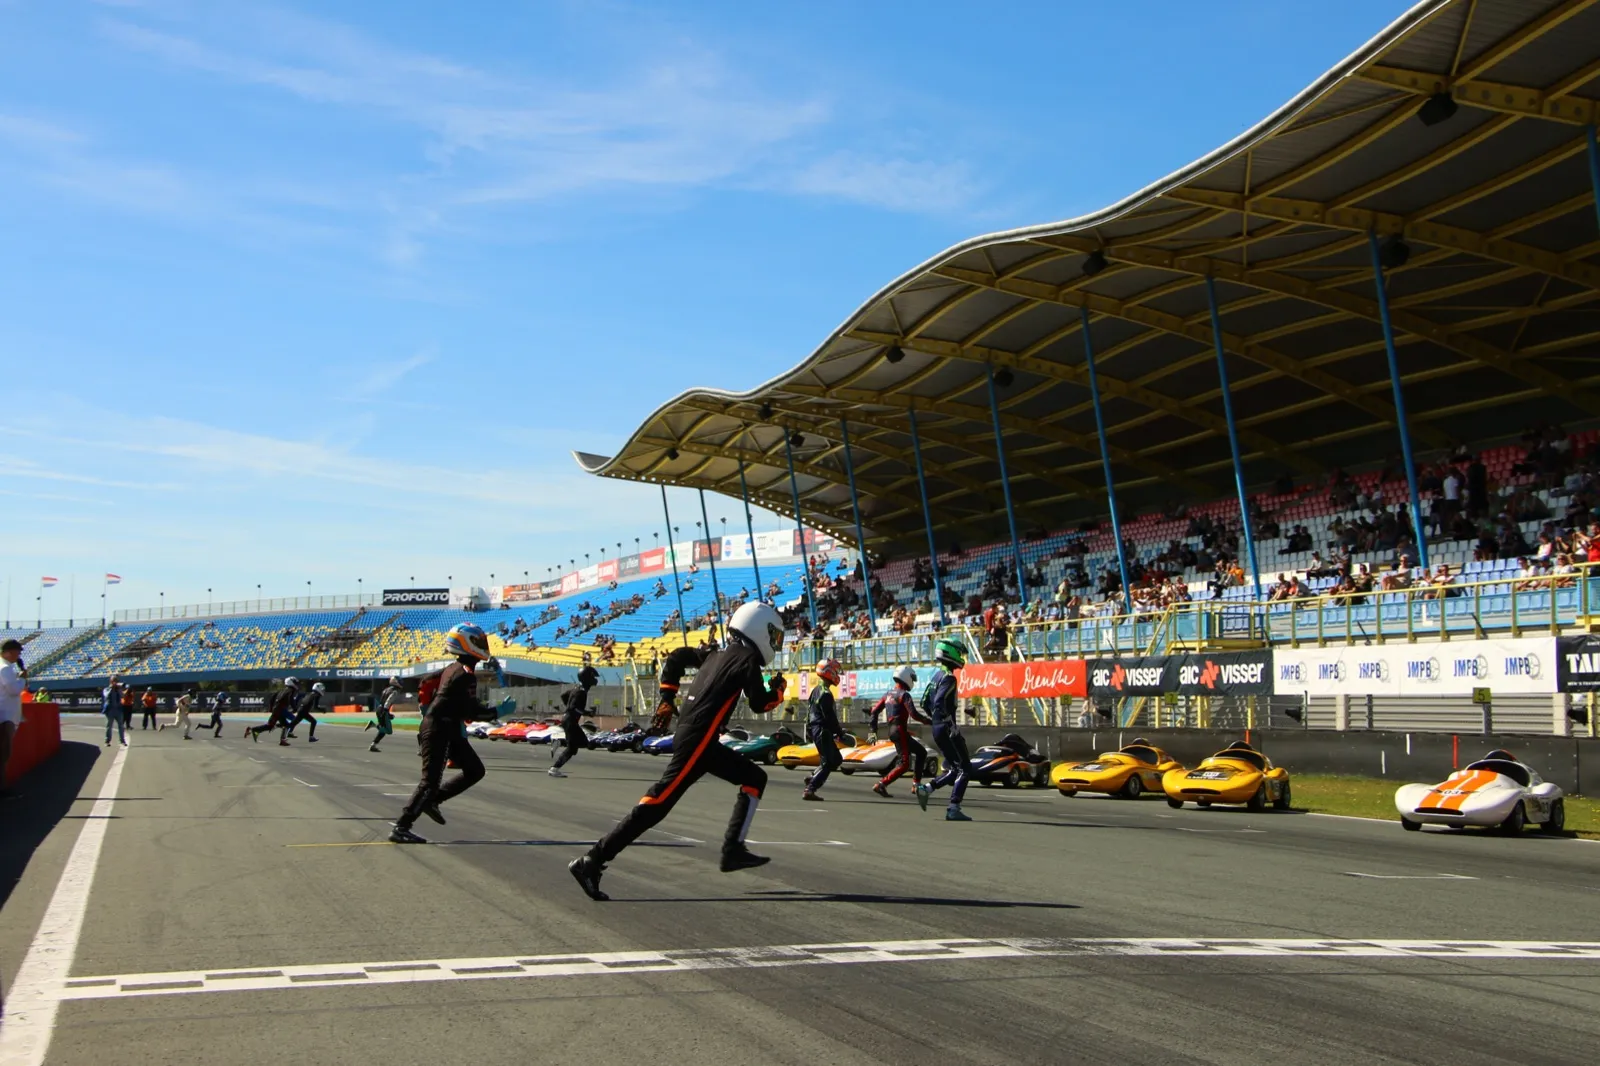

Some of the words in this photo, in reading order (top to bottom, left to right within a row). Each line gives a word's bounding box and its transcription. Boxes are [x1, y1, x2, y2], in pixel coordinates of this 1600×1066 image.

[384, 592, 449, 602] PROFORTO
[316, 669, 331, 677] TT
[336, 669, 375, 677] CIRCUIT
[1179, 662, 1199, 686] aic
[1220, 662, 1265, 685] visser
[1407, 660, 1432, 678] JMPB
[1453, 658, 1478, 677] JMPB
[1504, 656, 1531, 676] JMPB
[1020, 666, 1076, 694] Drenthe
[1092, 668, 1110, 686] aic
[1125, 667, 1164, 687] visser
[1478, 688, 1486, 701] 5
